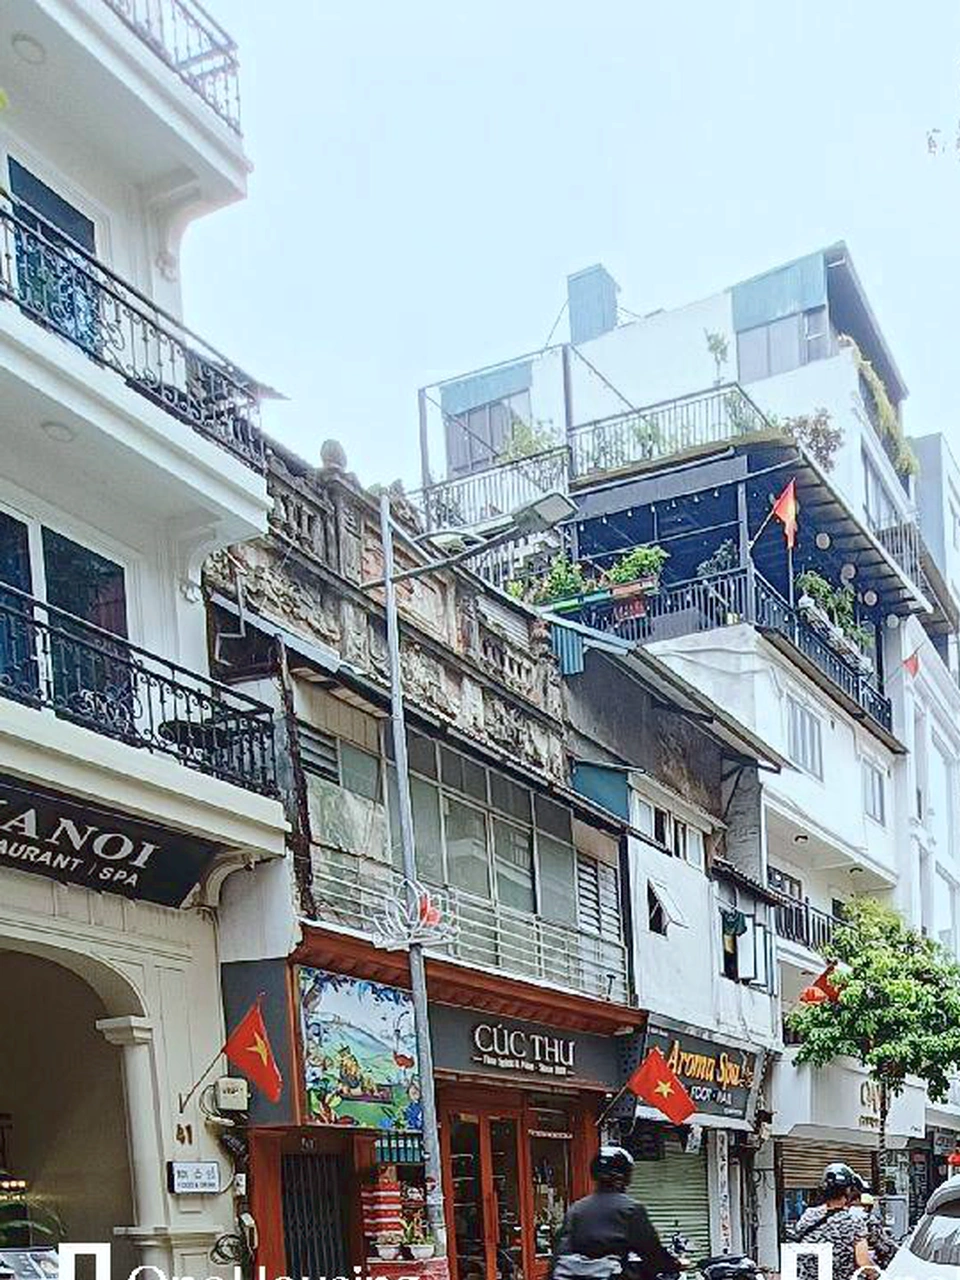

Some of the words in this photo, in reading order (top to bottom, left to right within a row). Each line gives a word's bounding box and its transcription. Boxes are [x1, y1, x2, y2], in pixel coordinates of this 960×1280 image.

[0, 799, 161, 869] ANOI
[99, 867, 139, 888] SPA
[474, 1023, 526, 1058] CÚC
[667, 1039, 716, 1082] Aroma
[175, 1122, 193, 1146] 41
